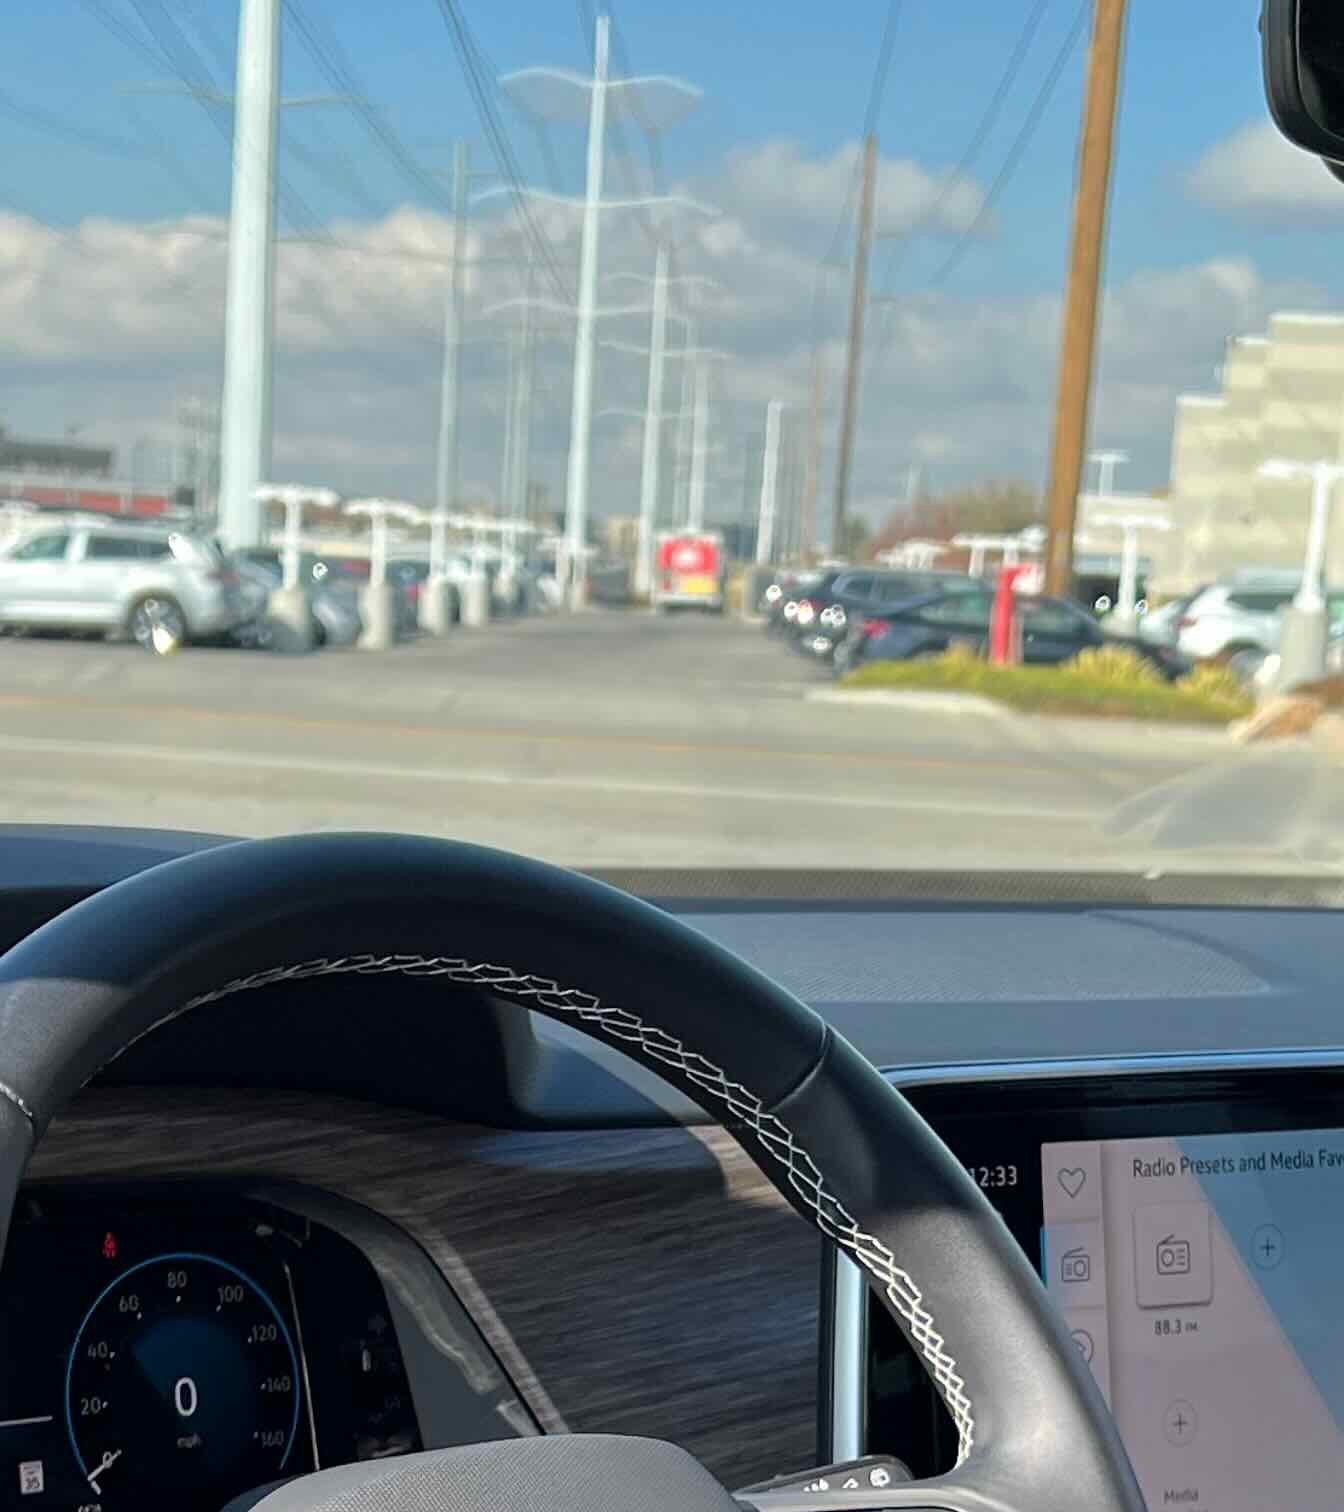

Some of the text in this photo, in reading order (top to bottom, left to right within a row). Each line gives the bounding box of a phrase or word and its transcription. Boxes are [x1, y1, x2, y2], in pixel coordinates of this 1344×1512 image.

[1132, 1157, 1176, 1178] Radio
[1179, 1154, 1235, 1175] Presets
[1239, 1152, 1266, 1172] and
[1270, 1148, 1314, 1171] Media
[167, 1271, 187, 1288] 80
[218, 1285, 244, 1303] 100
[119, 1295, 139, 1313] 60
[252, 1324, 277, 1341] 120
[87, 1341, 108, 1358] 40
[267, 1375, 291, 1392] 140
[175, 1377, 197, 1416] 0
[81, 1398, 102, 1415] 20
[261, 1430, 284, 1447] 160
